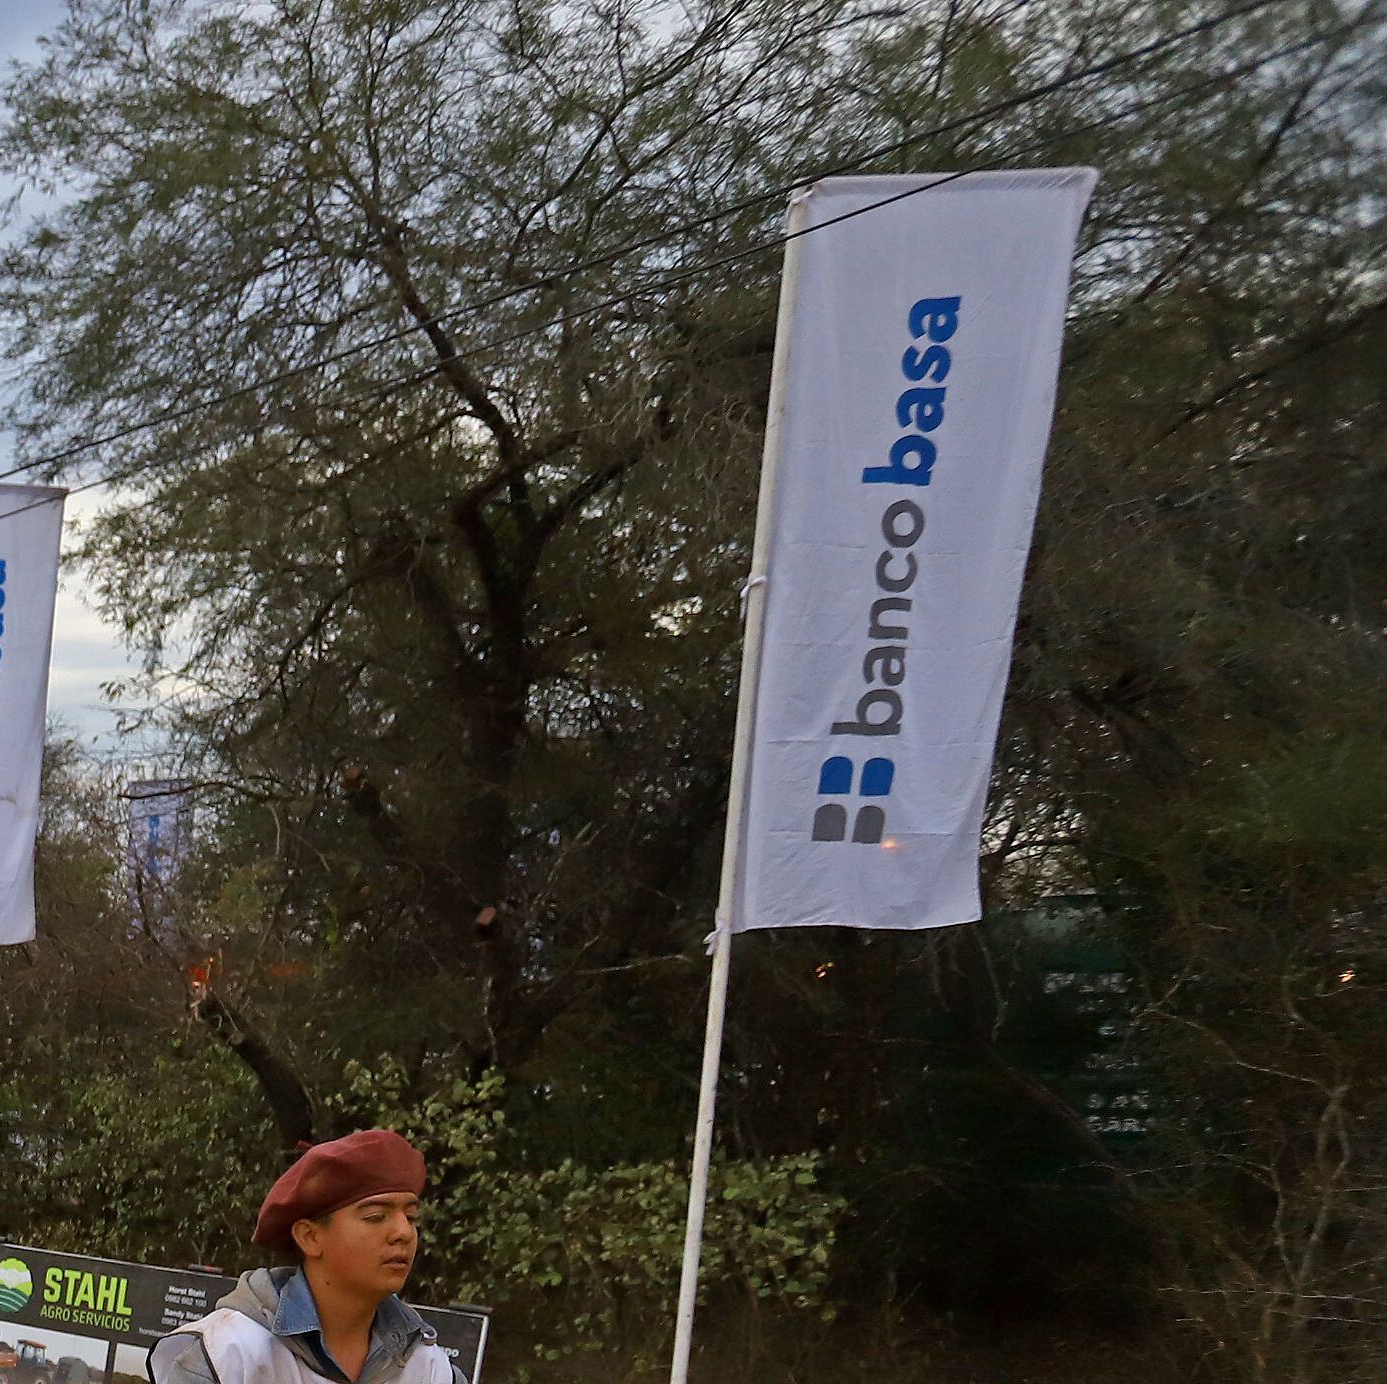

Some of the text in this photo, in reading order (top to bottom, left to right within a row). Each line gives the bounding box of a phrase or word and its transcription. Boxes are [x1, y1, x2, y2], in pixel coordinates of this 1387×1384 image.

[43, 1266, 133, 1316] STAHL
[40, 1304, 71, 1322] AGRO
[71, 1308, 131, 1332] SERVICIOS
